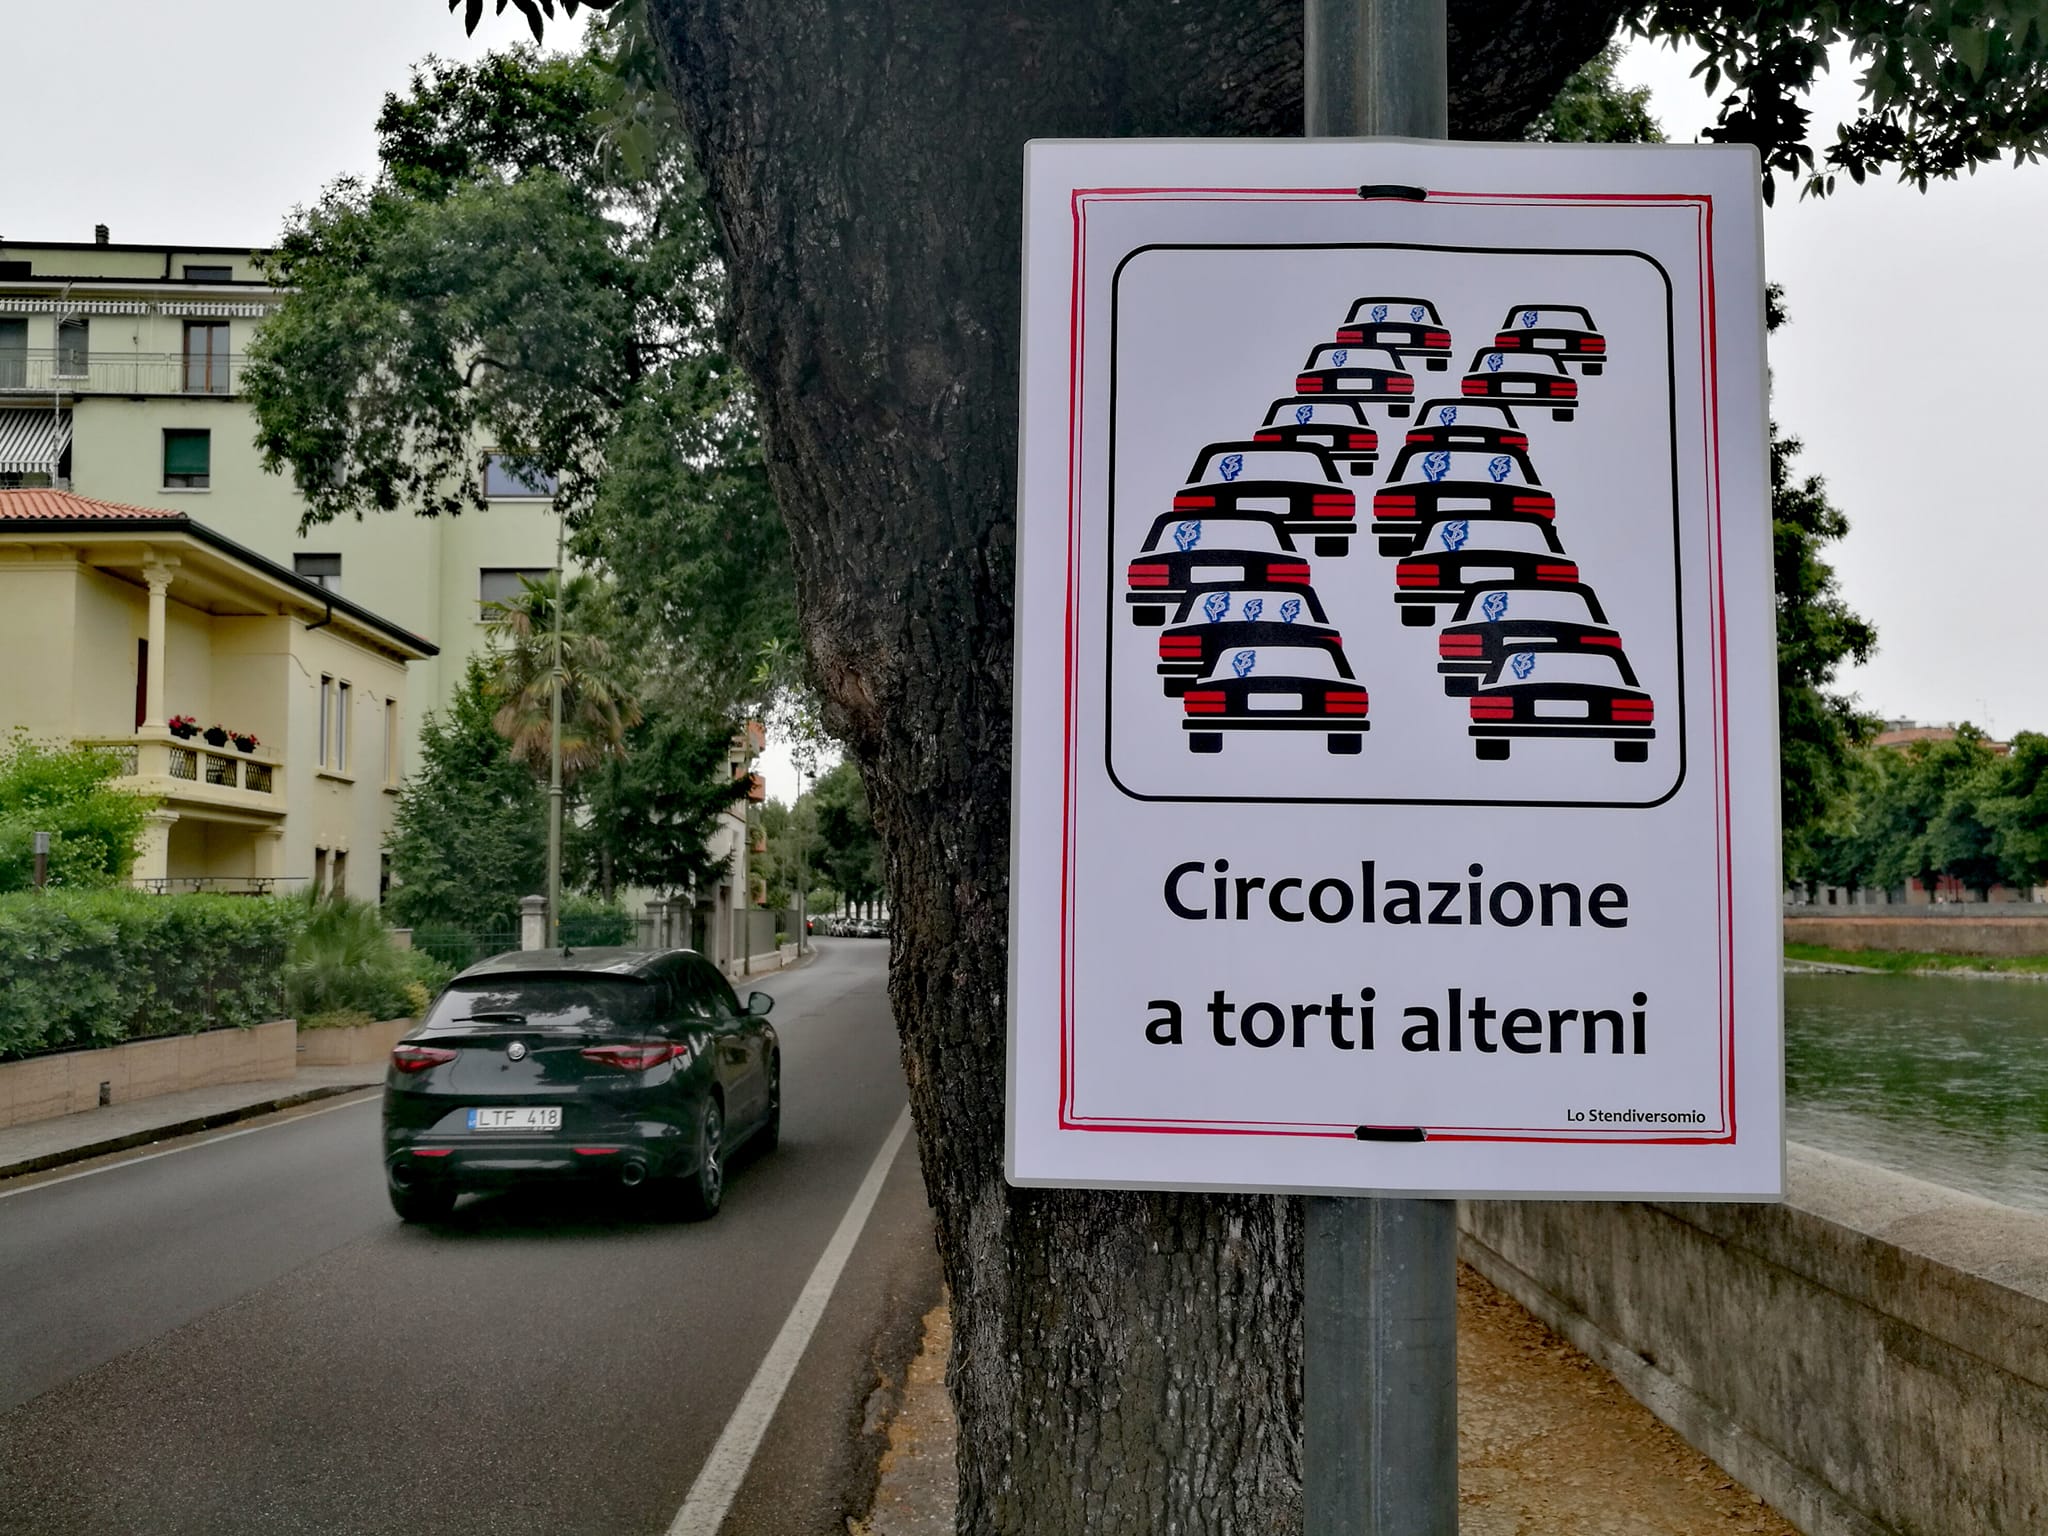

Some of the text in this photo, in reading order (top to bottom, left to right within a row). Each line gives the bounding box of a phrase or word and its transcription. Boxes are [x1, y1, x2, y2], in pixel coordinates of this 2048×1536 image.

[1164, 859, 1629, 928] Circolazione
[1146, 987, 1647, 1054] a torti alterni
[479, 1110, 516, 1126] LTF
[527, 1109, 557, 1125] 418
[1567, 1108, 1706, 1124] Lo Stendiversomio
